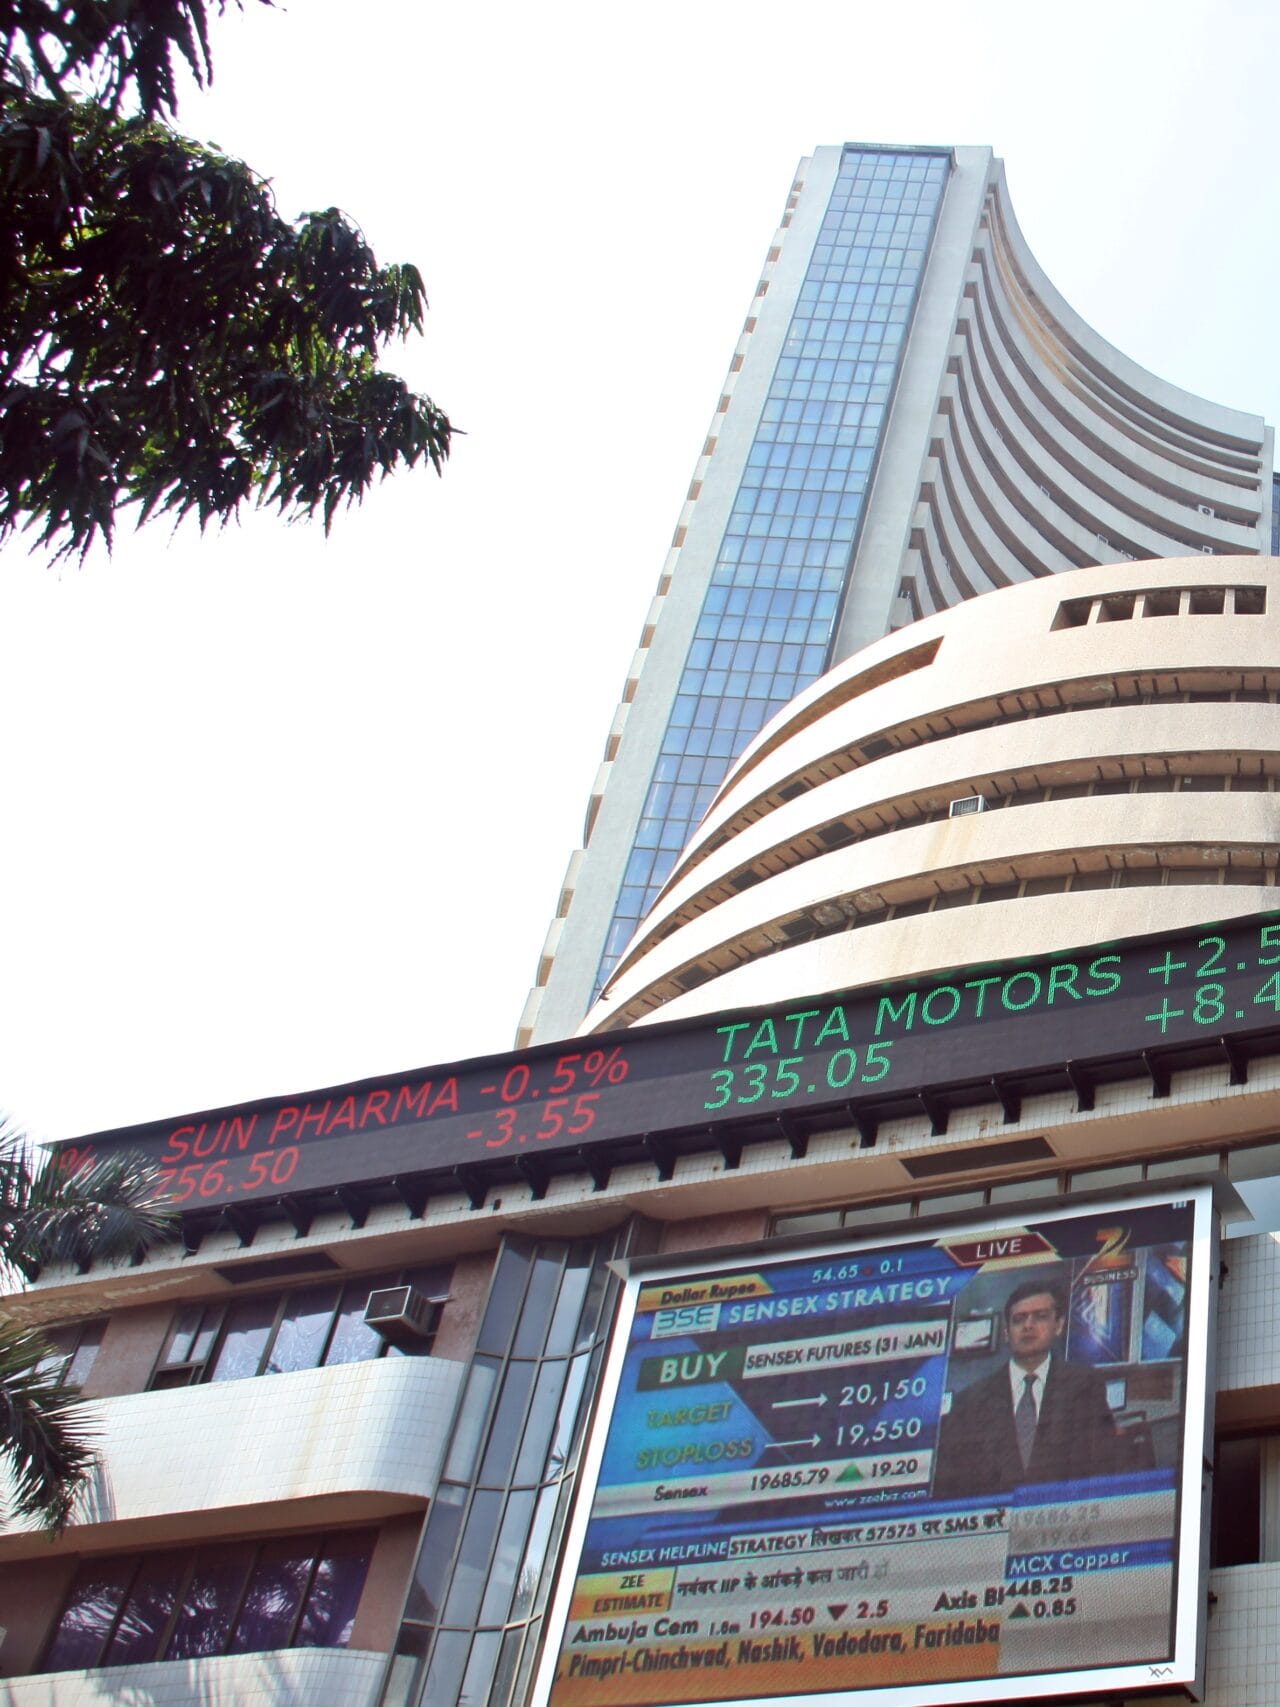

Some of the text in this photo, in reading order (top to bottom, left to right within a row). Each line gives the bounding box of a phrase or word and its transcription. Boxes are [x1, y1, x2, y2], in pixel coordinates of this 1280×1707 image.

[716, 1005, 850, 1063] TATA
[873, 954, 1122, 1037] MOTORS
[703, 1040, 893, 1110] 335.05
[160, 1046, 629, 1164] SUN PHARMA -0.5%
[466, 1094, 601, 1149] -3.55
[975, 1237, 1022, 1259] LIVE
[660, 1258, 903, 1306] Dollar Rupee 54.65 0.1
[1083, 1269, 1137, 1285] BUSINESS
[728, 1276, 952, 1325] SENSEX STRATEGY
[746, 1328, 944, 1371] SENSEX FUTURES (31 JAN)
[659, 1351, 728, 1384] BUY
[839, 1377, 927, 1407] 20,150
[647, 1402, 732, 1428] TARGET
[836, 1417, 922, 1447] 19,550
[636, 1438, 752, 1469] STOPLOSS
[653, 1458, 919, 1501] Sensex 19685.79 19.20
[730, 1533, 806, 1555] STRATEGY
[865, 1522, 917, 1541] 57575
[944, 1515, 979, 1532] SMS
[600, 1541, 727, 1567] SENSEX HELPLINE
[1010, 1549, 1130, 1576] MCX Copper
[620, 1574, 646, 1589] ZEE
[1006, 1576, 1073, 1598] 448.25
[571, 1621, 648, 1644] Ambuja
[653, 1617, 699, 1636] Cem
[749, 1606, 816, 1629] 194.50
[857, 1599, 889, 1619] 2.5
[933, 1590, 977, 1612] Axis
[593, 1592, 664, 1613] ESTIMATE
[1032, 1598, 1077, 1618] 0.85
[737, 1635, 805, 1662] Nashik,
